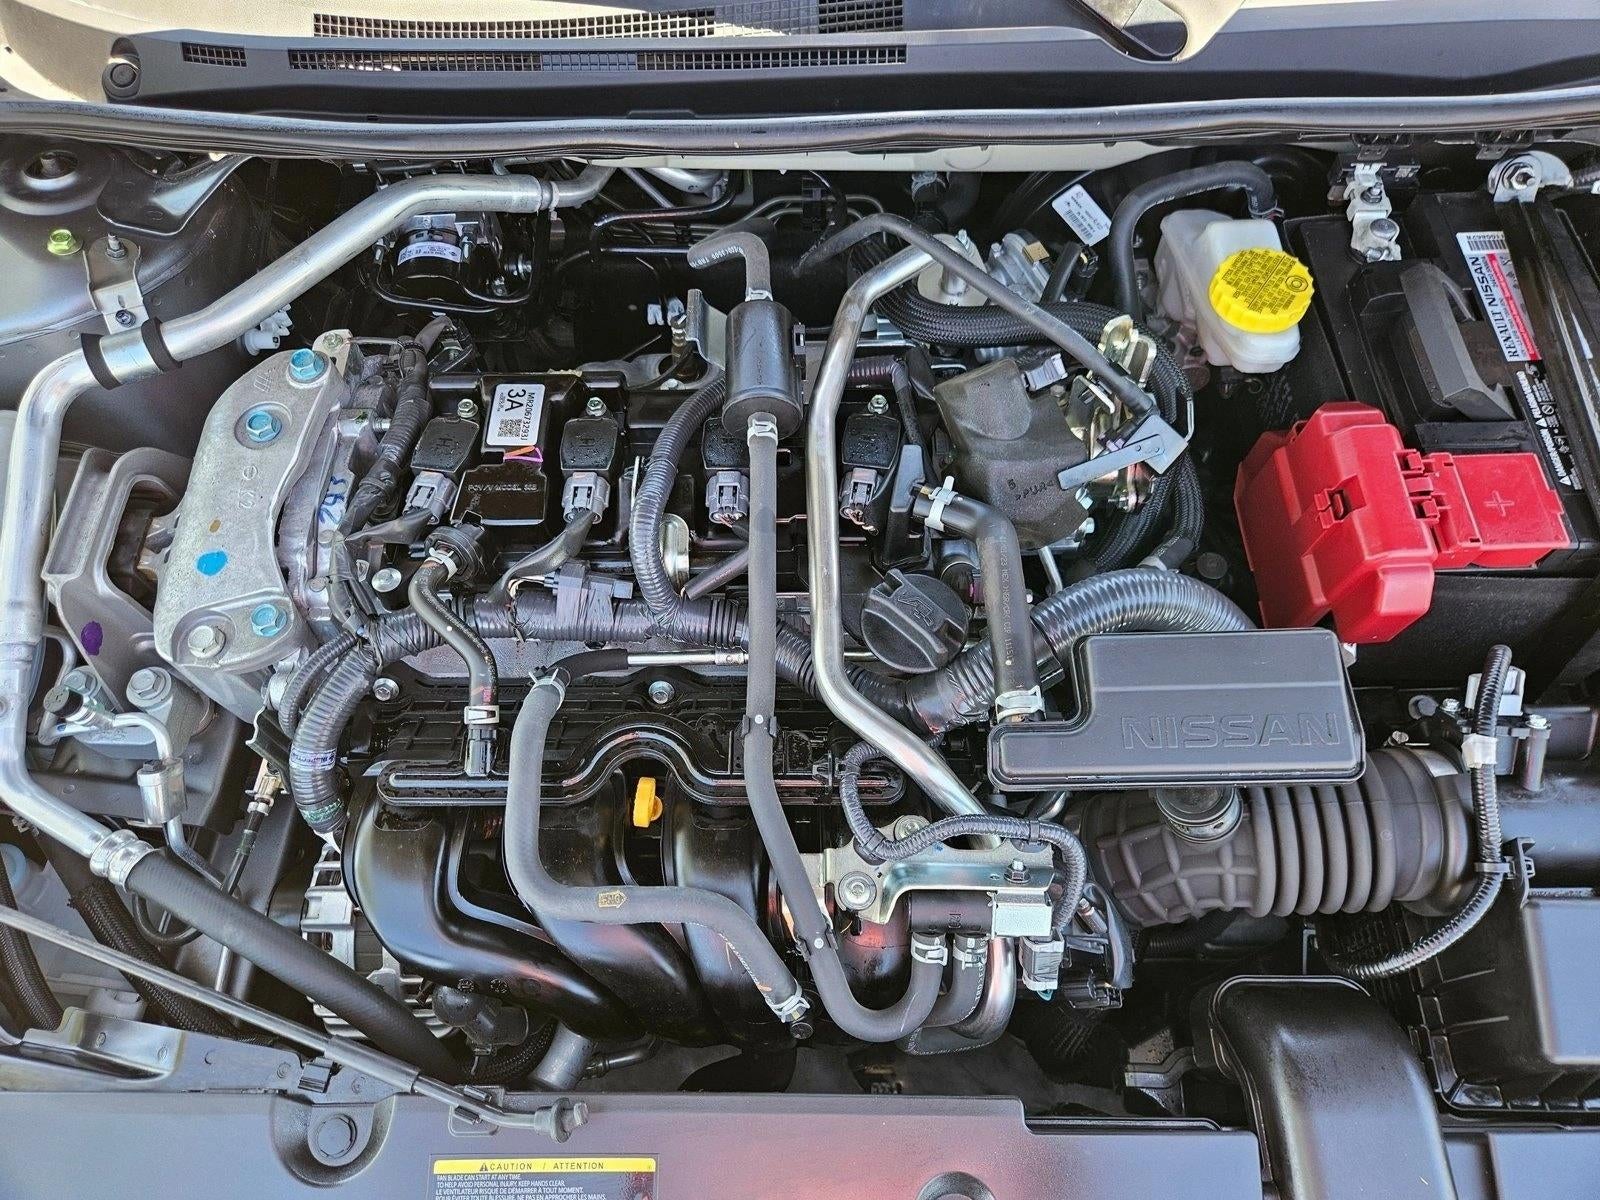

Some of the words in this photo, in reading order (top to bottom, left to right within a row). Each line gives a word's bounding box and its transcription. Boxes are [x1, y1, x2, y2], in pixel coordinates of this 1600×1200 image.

[1468, 256, 1498, 307] NISSAN
[1491, 311, 1519, 358] RENAULT
[505, 388, 526, 412] 3A
[520, 392, 536, 440] MR20673293J
[1121, 712, 1340, 749] NISSAN
